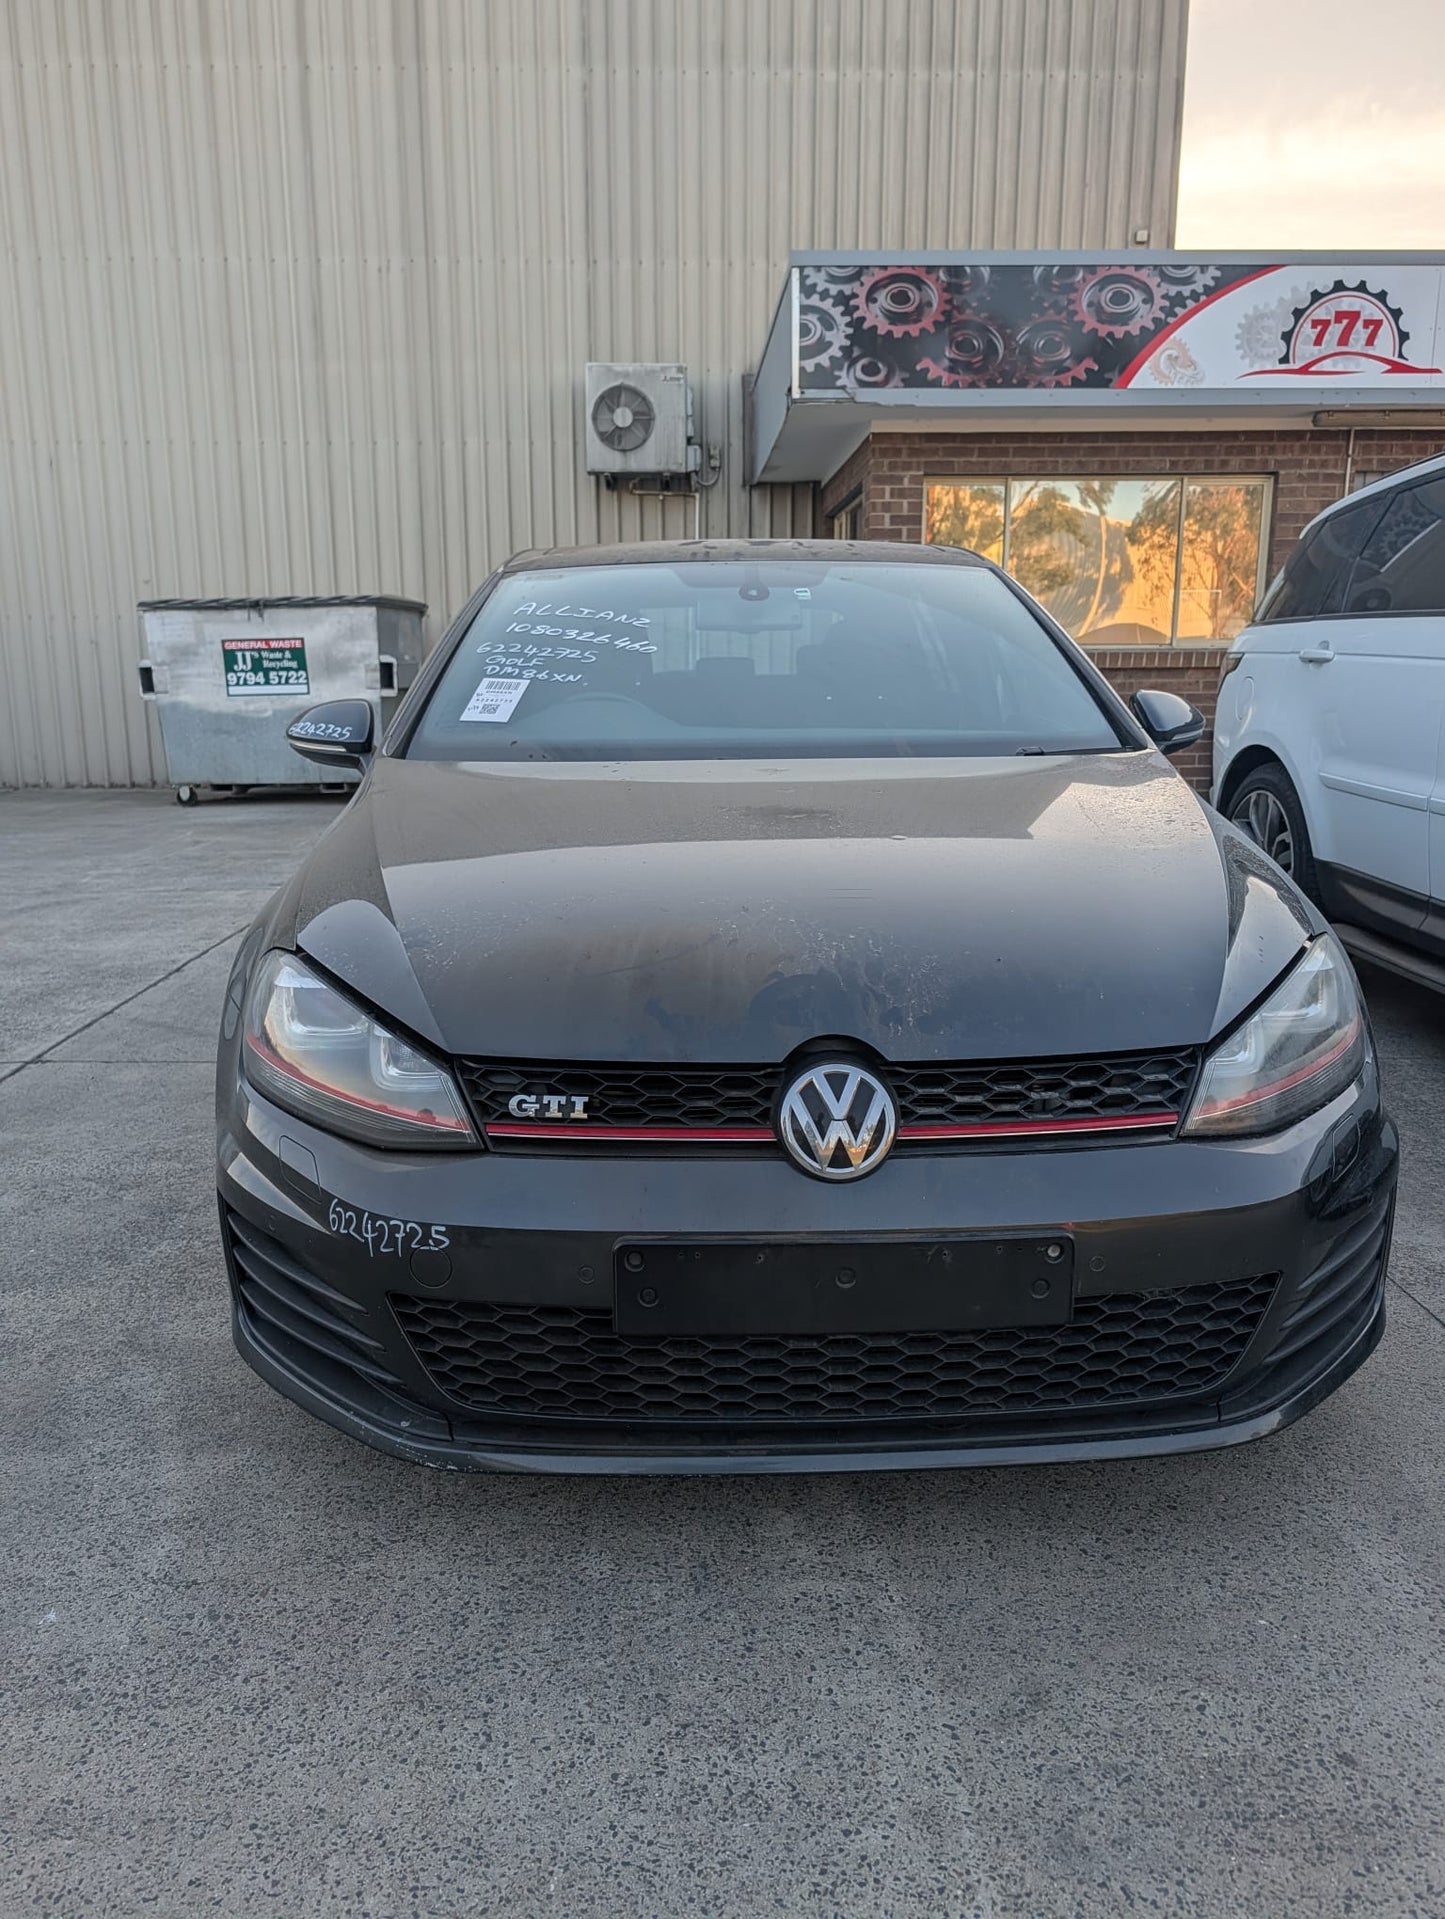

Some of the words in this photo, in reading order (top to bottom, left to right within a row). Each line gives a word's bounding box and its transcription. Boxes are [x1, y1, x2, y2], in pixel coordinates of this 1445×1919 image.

[1310, 310, 1384, 347] 777
[513, 602, 651, 628] ALLIANZ
[224, 641, 267, 650] GENERAL
[270, 640, 302, 648] WASTE
[506, 622, 658, 654] 1080326460
[261, 651, 282, 659] Waste
[284, 650, 291, 659] &
[476, 641, 599, 663] 62242725
[485, 655, 544, 667] GOLF
[263, 660, 298, 669] Recycling
[227, 671, 265, 685] 9794
[269, 670, 307, 684] 5722
[508, 1094, 589, 1119] GTI
[780, 1063, 896, 1180] VW
[329, 1198, 450, 1257] 62242725
